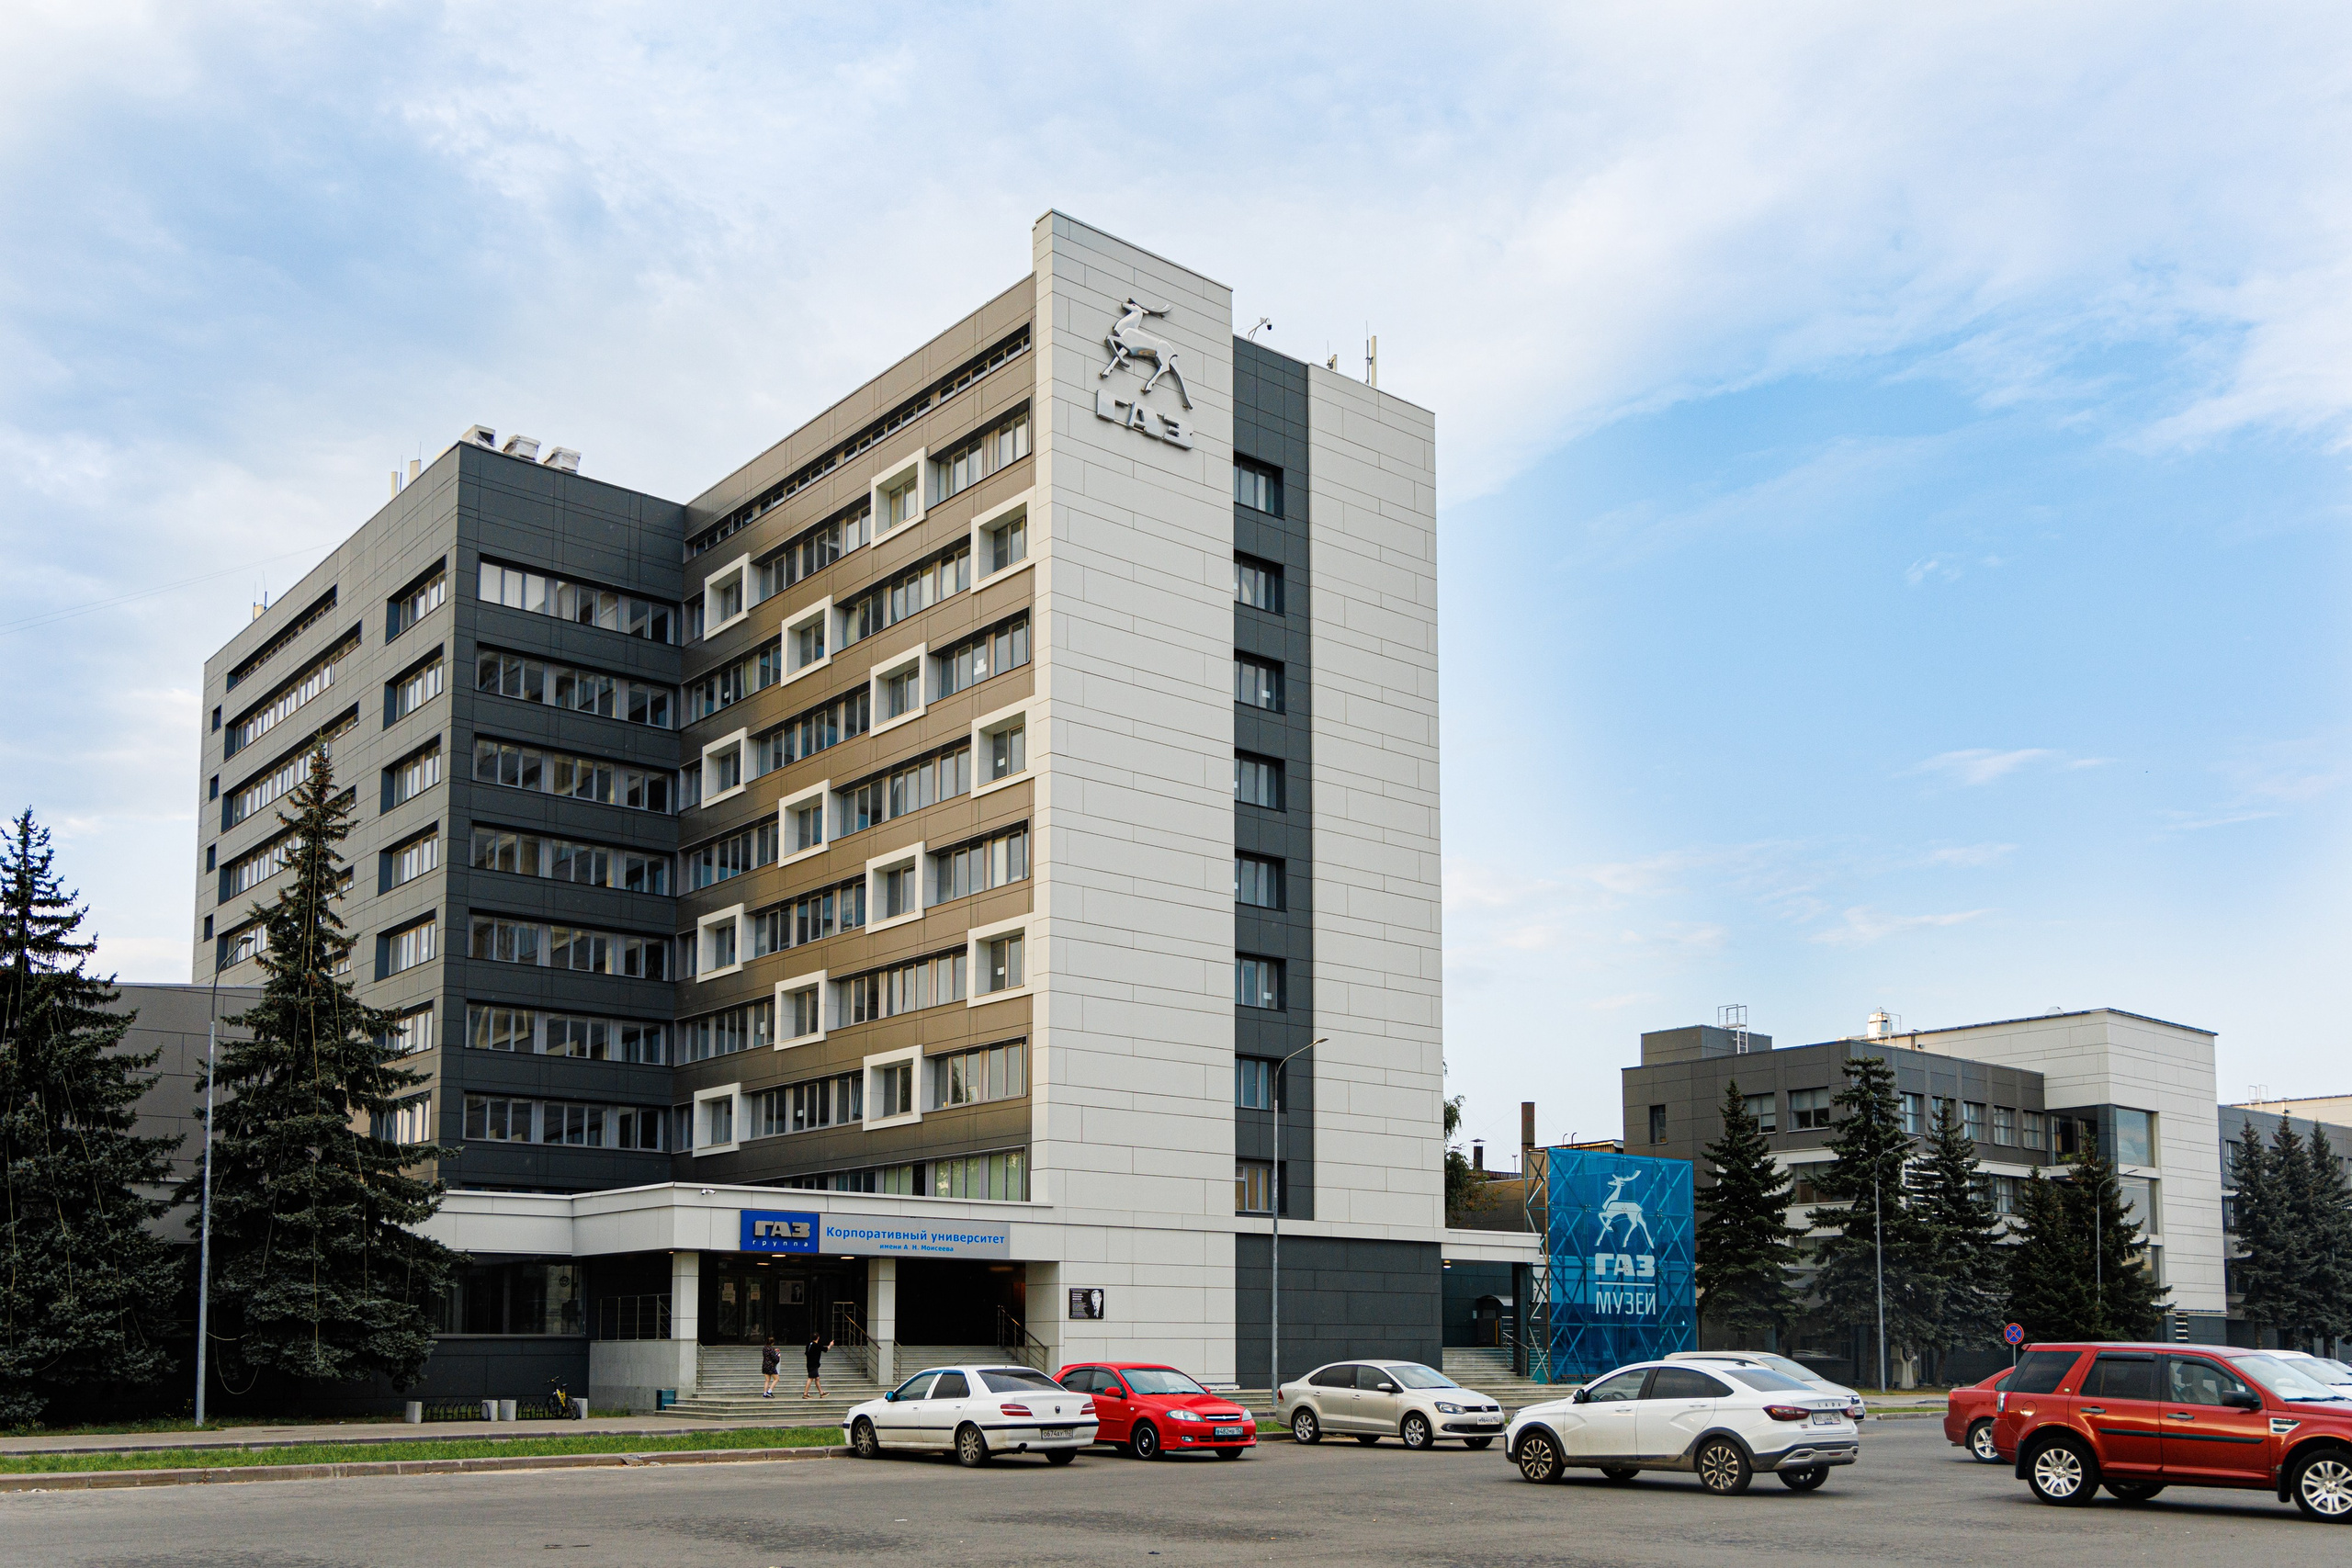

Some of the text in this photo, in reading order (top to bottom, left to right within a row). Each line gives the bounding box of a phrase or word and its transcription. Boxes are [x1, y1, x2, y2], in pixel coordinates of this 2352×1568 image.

[1096, 389, 1194, 450] ГАЗ
[754, 1220, 810, 1238] ГАЗ
[826, 1226, 1005, 1245] Корпоративный университет
[752, 1239, 808, 1247] группа
[921, 1244, 954, 1252] Моисеева
[1595, 1253, 1656, 1277] ГАЗ
[1595, 1291, 1657, 1315] МУЗЕЙ
